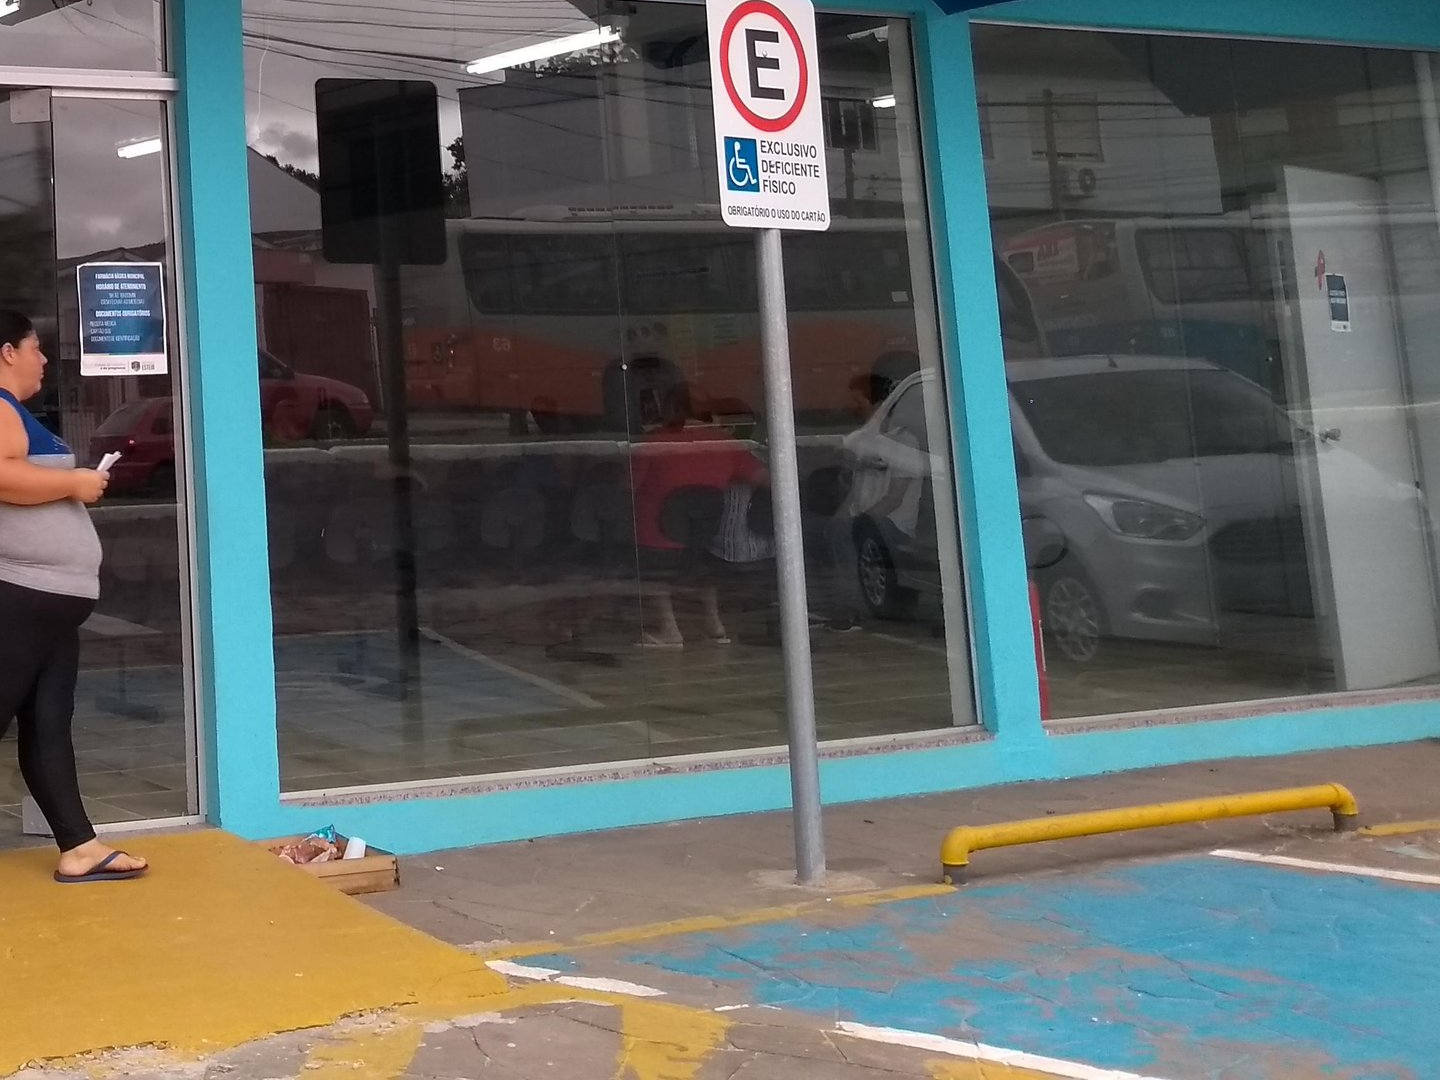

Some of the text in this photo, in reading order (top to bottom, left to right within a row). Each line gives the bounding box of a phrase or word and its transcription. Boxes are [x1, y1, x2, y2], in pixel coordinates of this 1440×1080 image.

[744, 28, 785, 101] E
[760, 139, 817, 159] EXCLUSIVO
[762, 159, 820, 178] DEFICIENTE
[763, 175, 796, 195] FÍSICO
[728, 204, 826, 223] OBRIGATÓRIO O USO DO CARTÃO
